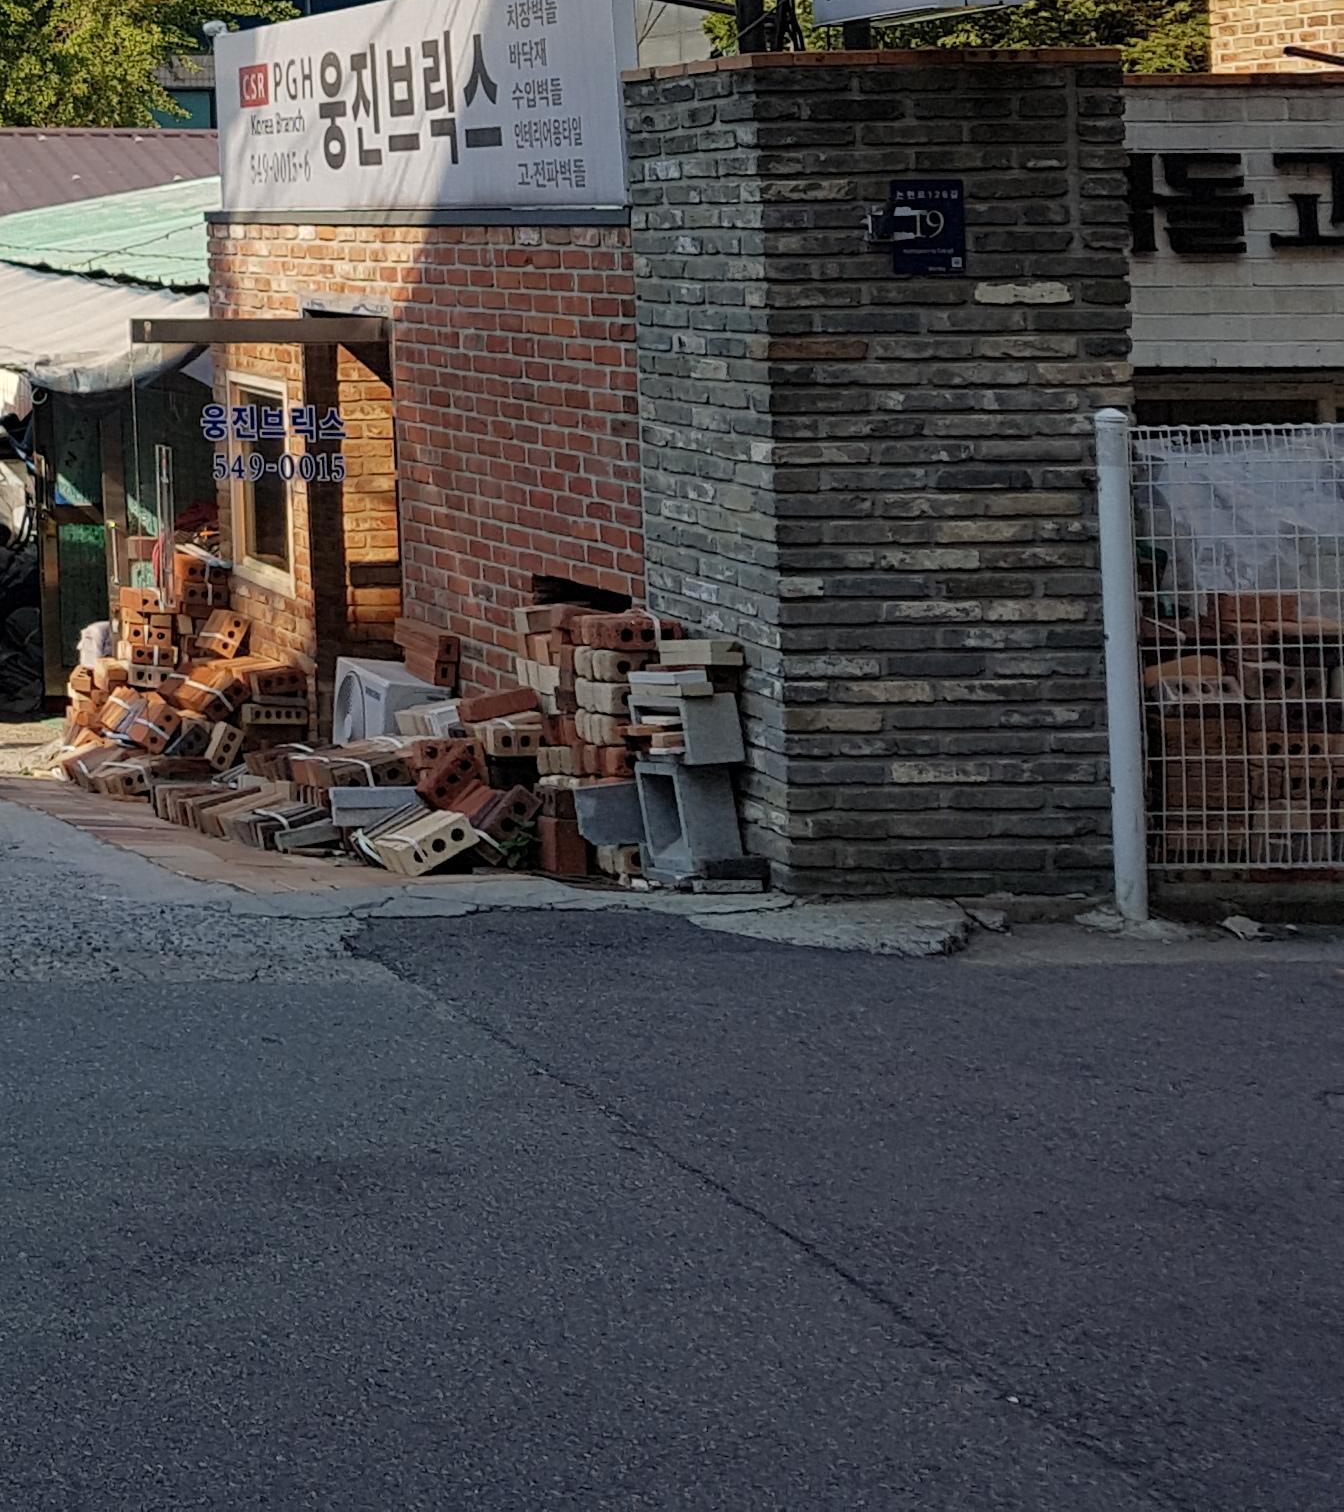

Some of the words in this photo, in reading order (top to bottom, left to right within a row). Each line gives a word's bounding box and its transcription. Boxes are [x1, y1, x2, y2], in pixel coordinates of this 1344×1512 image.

[508, 38, 547, 70] 바닥재
[243, 72, 266, 100] CSR
[319, 30, 502, 170] 웅진브릭스
[512, 77, 563, 109] 수입벽돌
[250, 113, 274, 136] Korea
[275, 107, 306, 135] Branch
[914, 210, 945, 238] 19
[200, 404, 347, 443] 웅진브릭스
[212, 452, 347, 482] 549-0015
